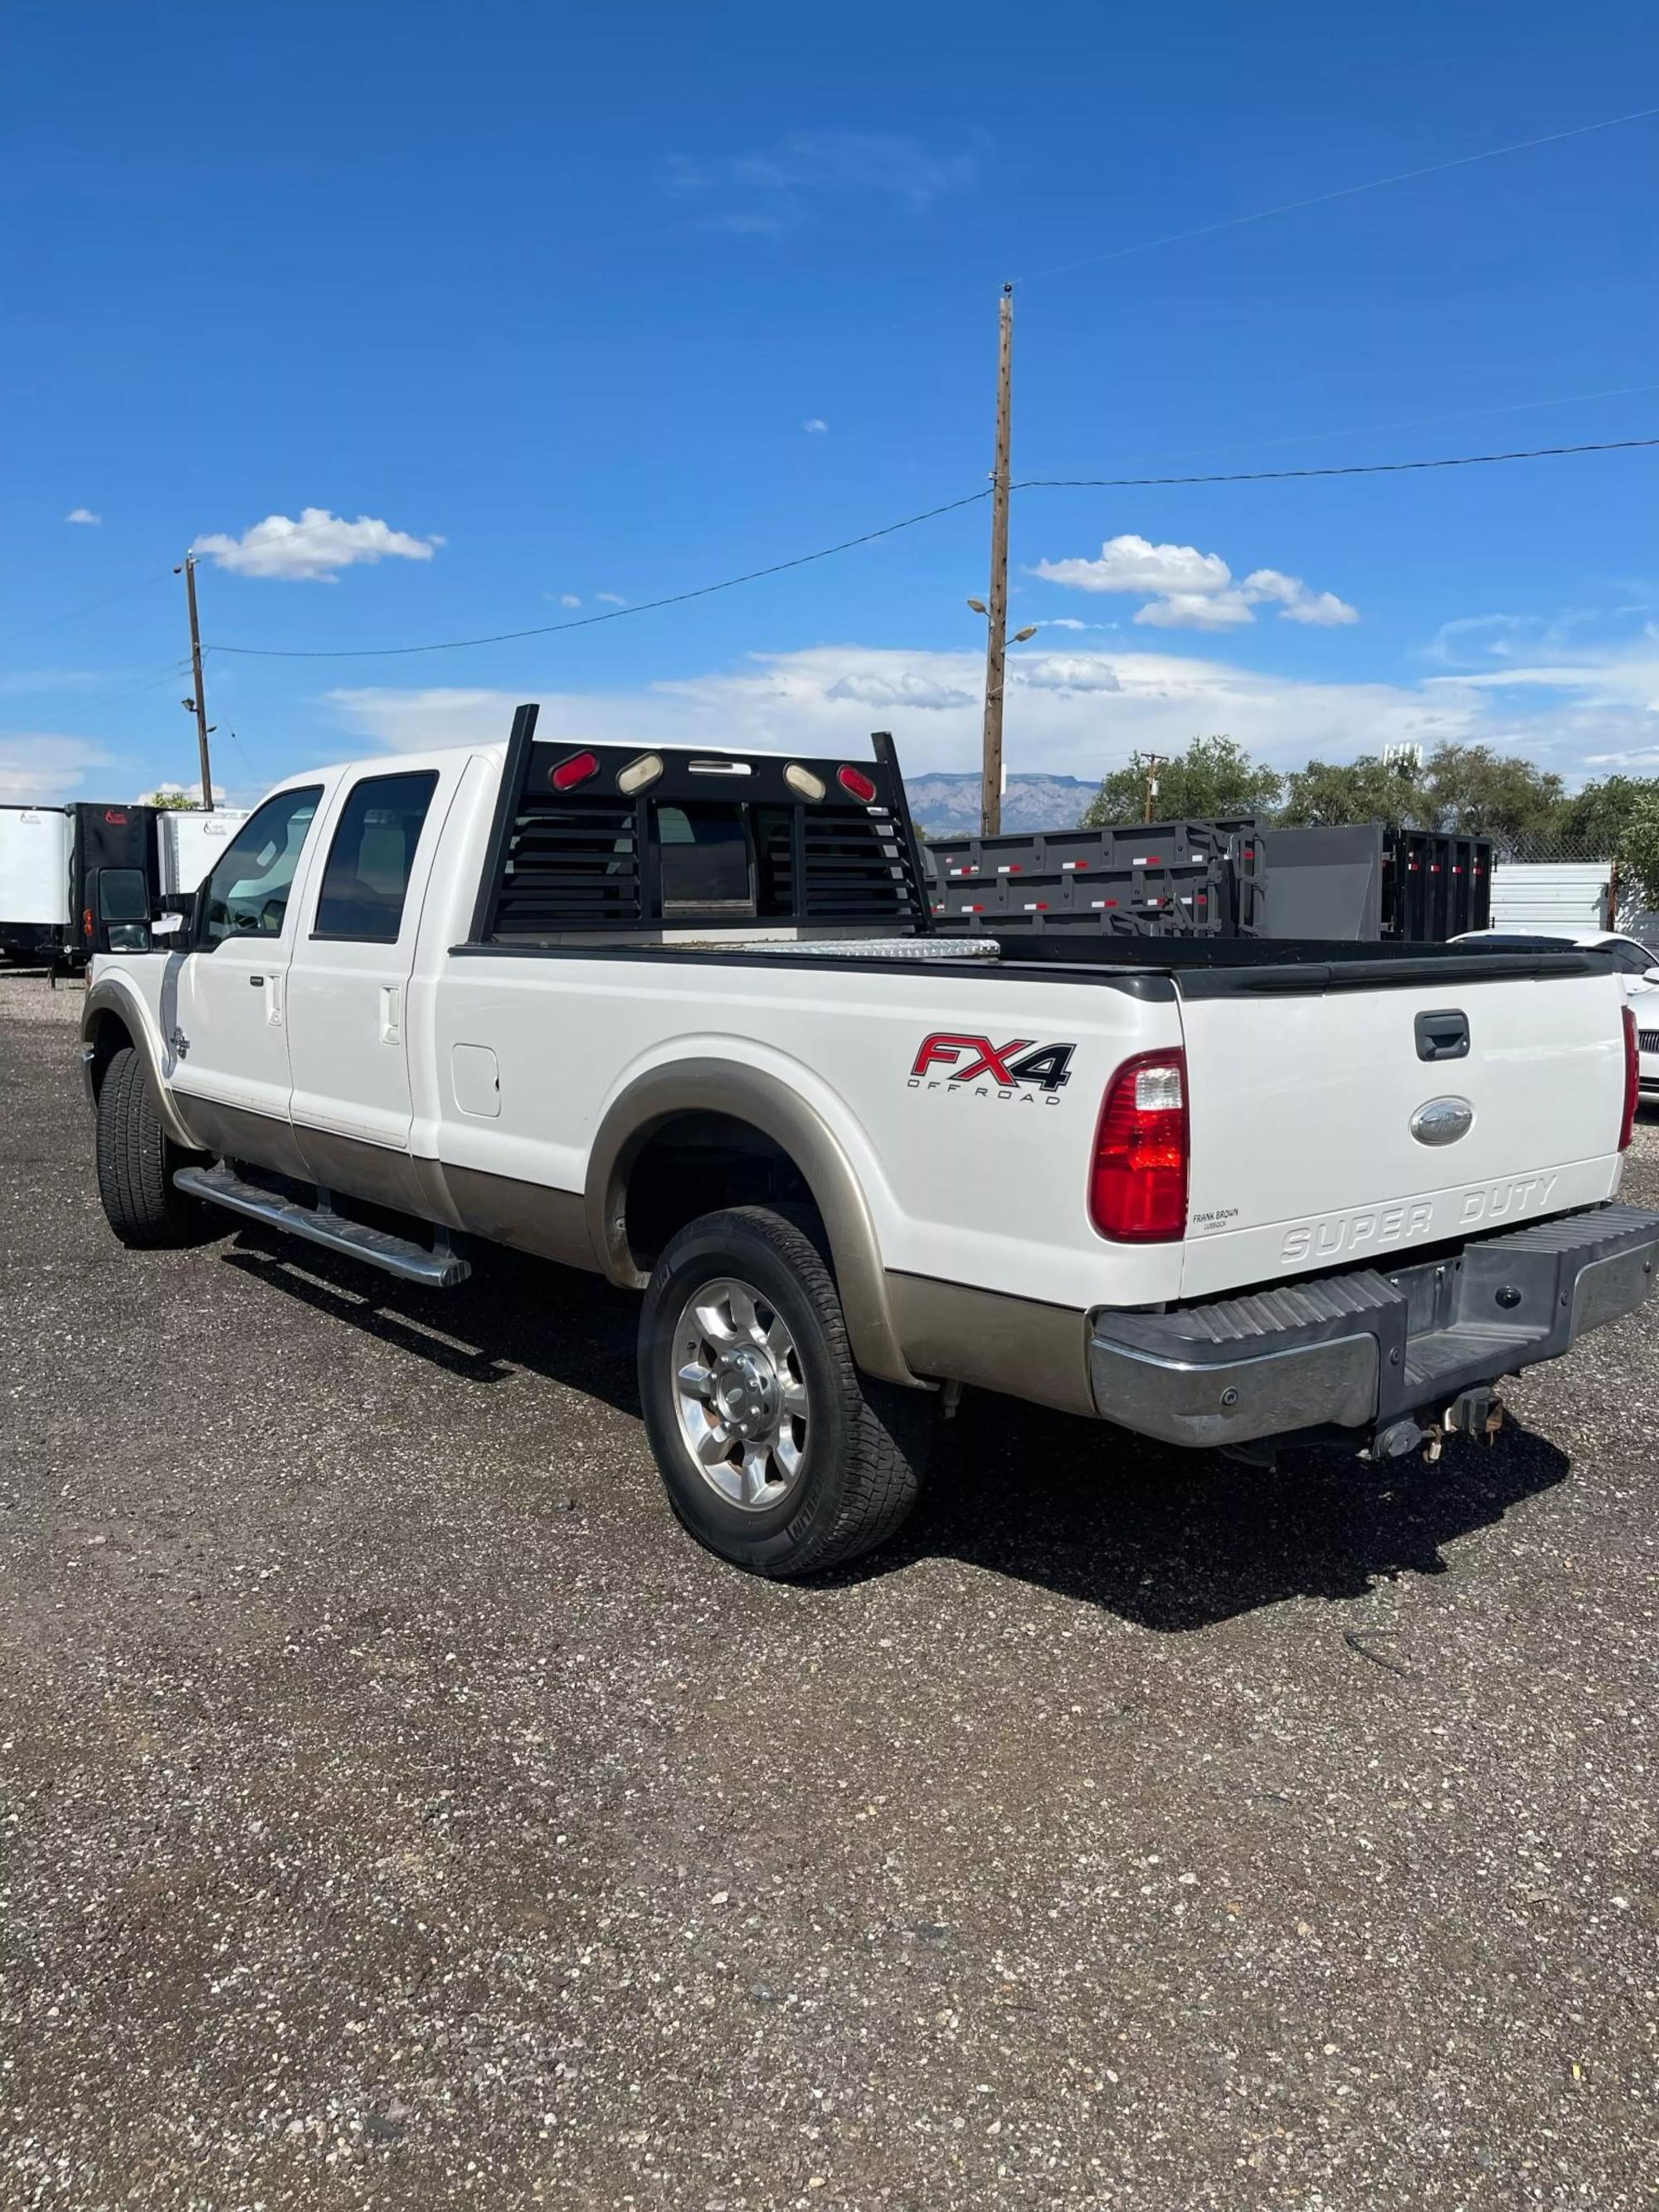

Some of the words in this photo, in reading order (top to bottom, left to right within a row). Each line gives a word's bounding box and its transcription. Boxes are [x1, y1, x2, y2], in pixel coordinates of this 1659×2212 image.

[910, 1032, 1078, 1092] FX4
[907, 1079, 961, 1092] OFF
[975, 1087, 1061, 1106] ROAD
[1193, 1212, 1214, 1223] FRANK
[1216, 1208, 1239, 1219] BROWN
[1280, 1202, 1434, 1264] SUPER
[1458, 1174, 1558, 1225] DUTY
